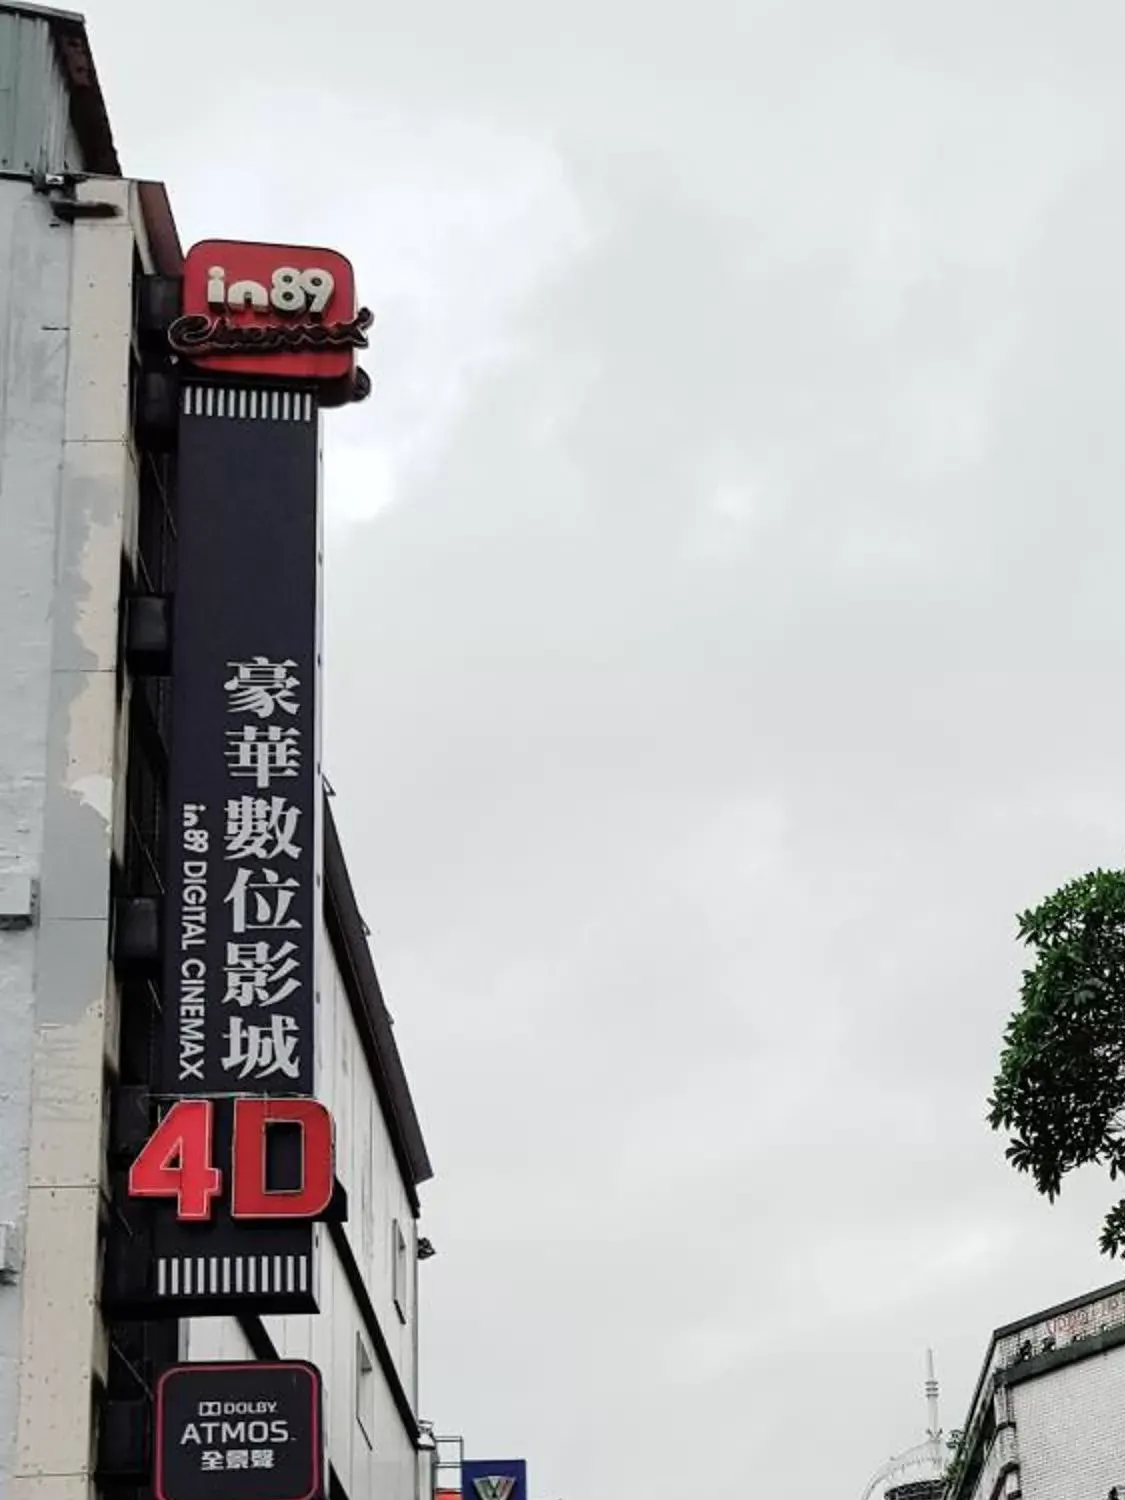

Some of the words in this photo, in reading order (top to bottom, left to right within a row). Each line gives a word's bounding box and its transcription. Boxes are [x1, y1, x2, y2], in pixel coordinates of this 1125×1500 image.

[207, 265, 335, 313] in89
[182, 804, 208, 852] in89
[222, 656, 302, 1080] 豪華數位影城
[181, 861, 207, 948] DIGITAL
[180, 957, 207, 1081] CINEMAX
[128, 1098, 335, 1221] 4D
[180, 1421, 289, 1445] ATMOS
[223, 1401, 277, 1415] DOLBY
